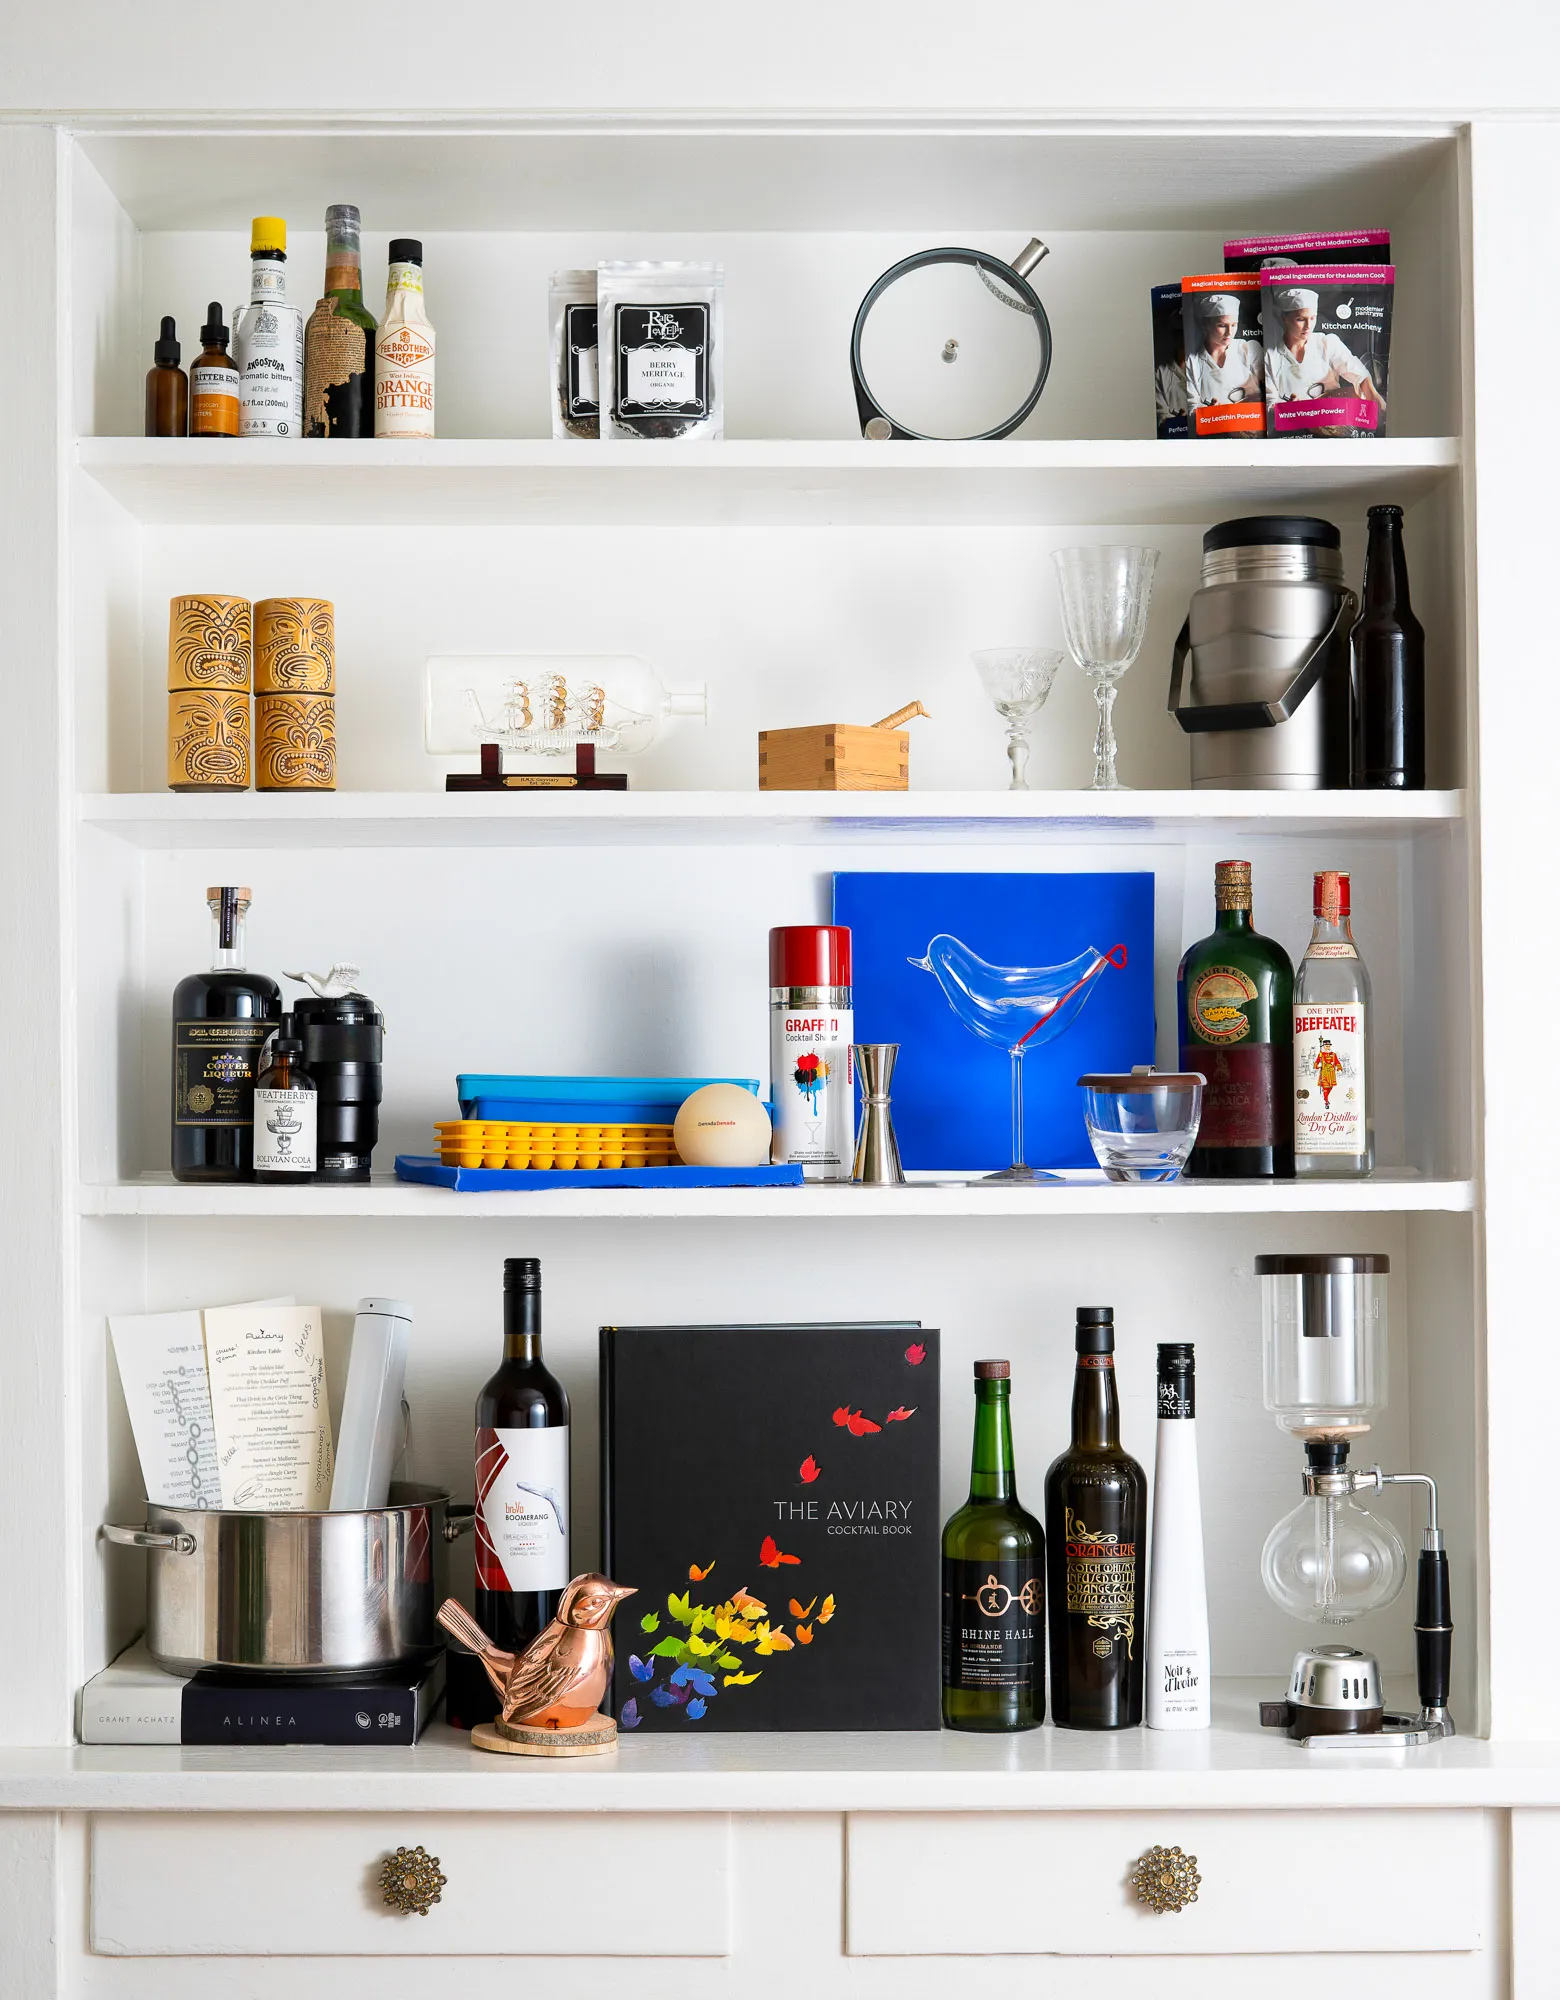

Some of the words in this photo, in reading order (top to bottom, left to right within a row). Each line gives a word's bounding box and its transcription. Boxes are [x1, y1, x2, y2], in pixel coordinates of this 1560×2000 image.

[1267, 243, 1304, 251] Ingredients
[1353, 323, 1381, 332] Alchemy
[381, 344, 391, 353] FEE
[392, 343, 430, 355] BROTHERS
[247, 358, 284, 371] ANGOSTURA
[195, 372, 224, 382] BITTER
[271, 372, 292, 381] bitters
[377, 380, 433, 396] ORANGE
[265, 399, 288, 408] (200mL)
[377, 394, 433, 410] BITTERS
[1196, 967, 1249, 984] BURKE'S
[786, 1019, 838, 1031] GRAFFTI
[1192, 1017, 1231, 1041] JAMAICA
[1236, 1025, 1248, 1037] RU
[1296, 1016, 1358, 1034] BEEFEATER
[256, 1091, 314, 1100] WEATHERBY'S
[1297, 1112, 1322, 1125] London
[1324, 1112, 1358, 1121] Distilled
[1308, 1122, 1326, 1135] Dry
[1329, 1122, 1344, 1135] Gin
[257, 1155, 290, 1163] BOLIVIAN
[773, 1501, 818, 1520] THE
[827, 1501, 913, 1519] AVIARY
[827, 1526, 879, 1535] COCKTAIL
[883, 1526, 912, 1534] BOOK
[1066, 1543, 1135, 1557] ORANGERIE
[1067, 1563, 1100, 1572] SCOTCH
[1103, 1563, 1135, 1572] WHISKY
[1067, 1573, 1109, 1583] INFUSED
[1111, 1572, 1135, 1582] WITH
[1067, 1583, 1110, 1593] ORANGE
[1112, 1582, 1134, 1593] ZEST
[1067, 1594, 1097, 1604] CASSIA
[1109, 1594, 1135, 1603] CLOVE
[962, 1629, 1000, 1640] RHINE
[1005, 1628, 1034, 1639] HALL
[1165, 1665, 1183, 1679] Noir
[1165, 1676, 1198, 1692] d'Ivoire
[224, 1716, 296, 1725] ALINEA
